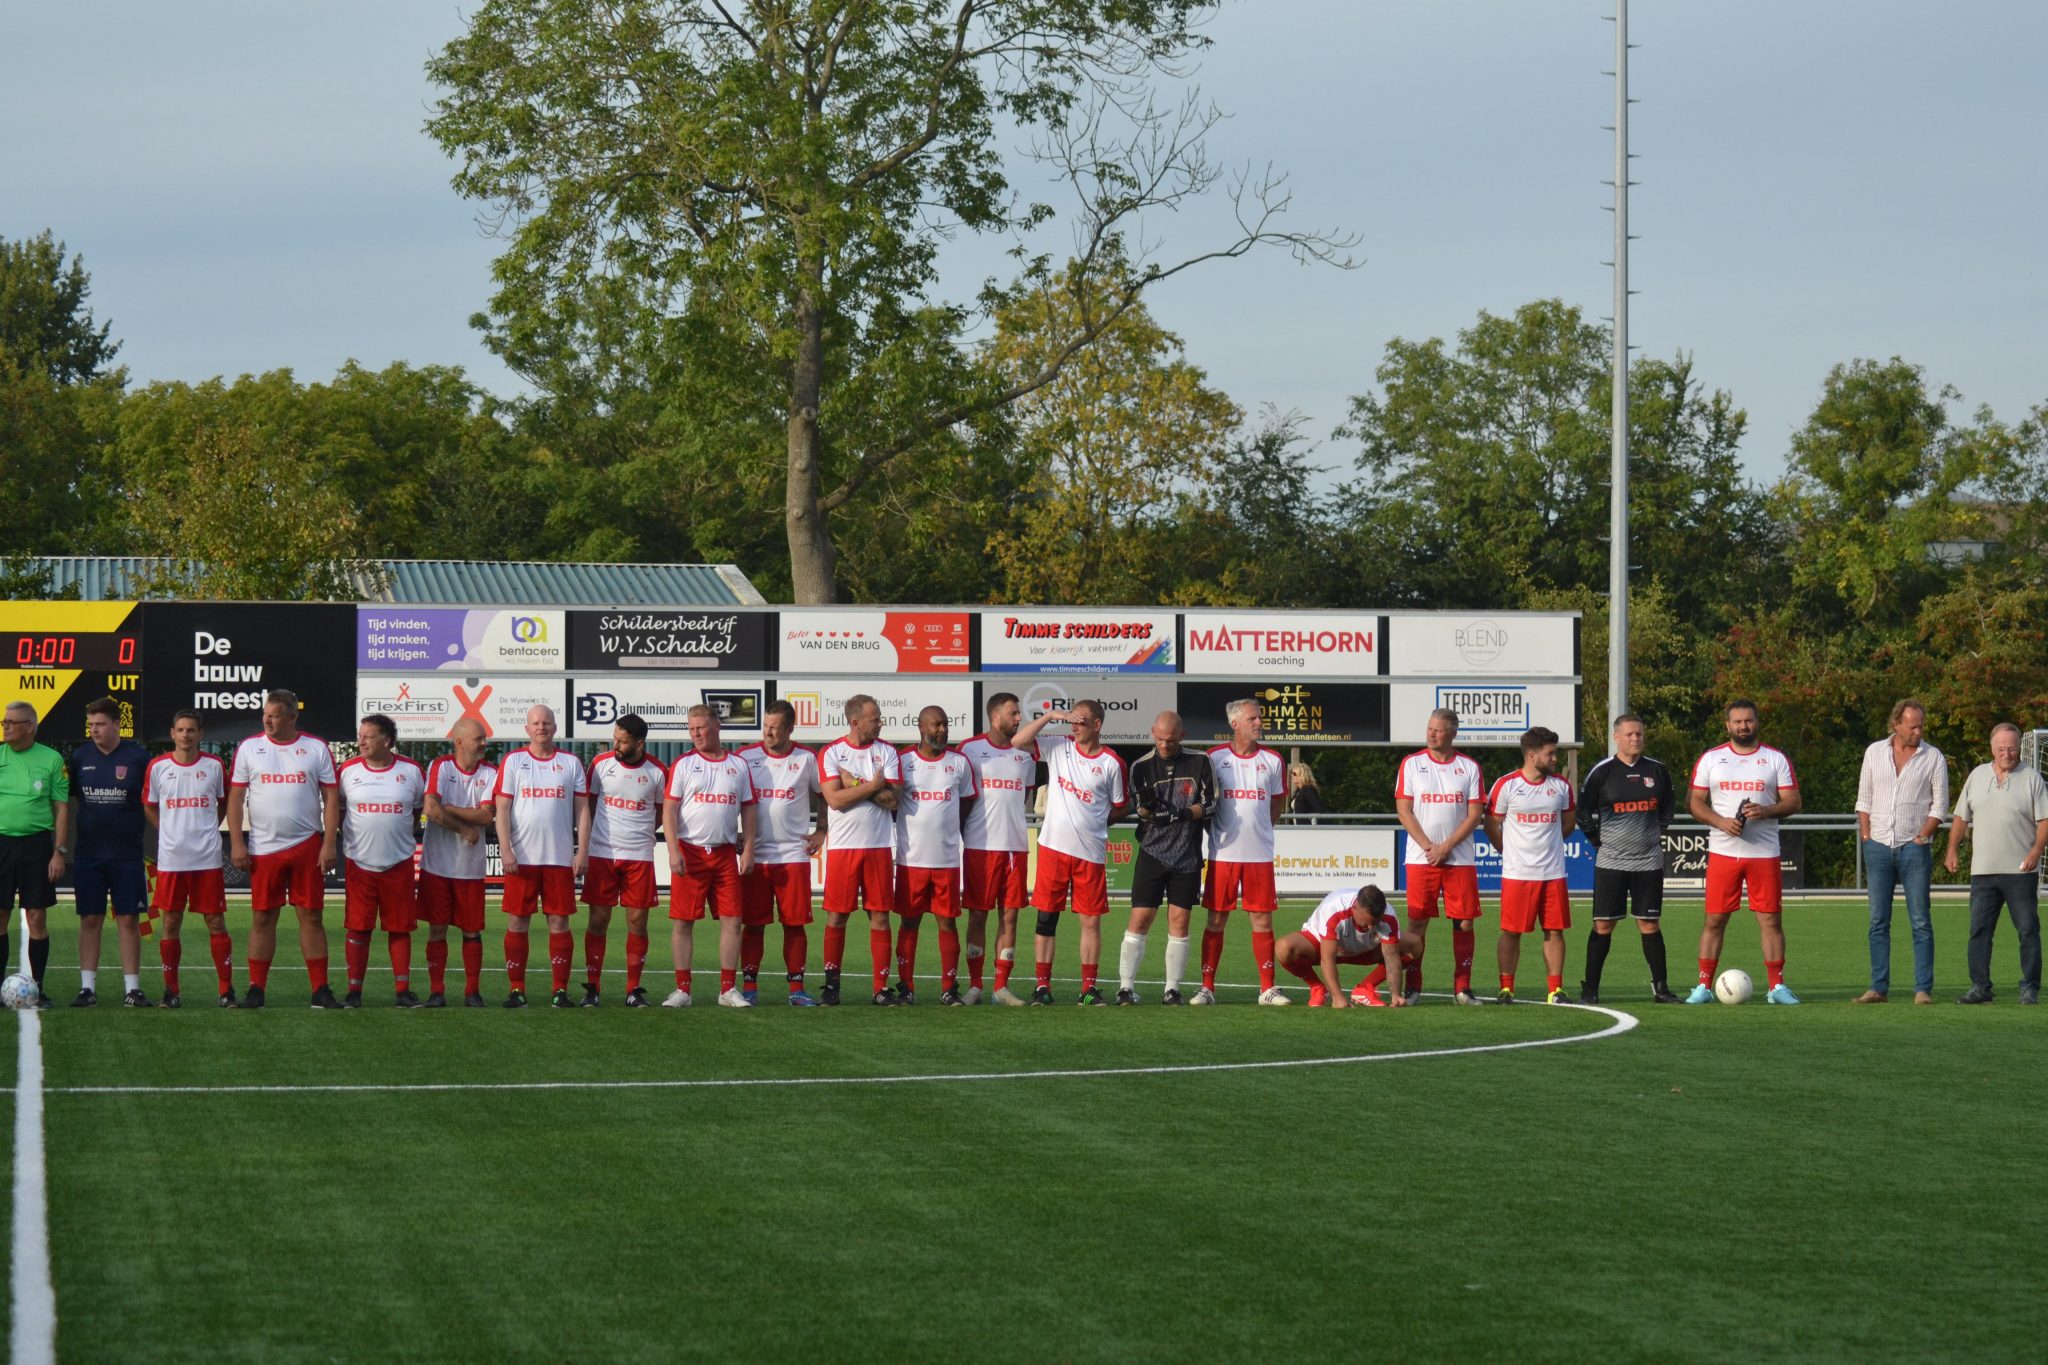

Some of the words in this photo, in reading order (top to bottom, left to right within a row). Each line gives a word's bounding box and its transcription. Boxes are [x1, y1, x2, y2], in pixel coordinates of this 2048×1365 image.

[368, 619, 386, 631] Tijd
[389, 619, 431, 631] vinden,
[600, 615, 737, 634] Schildersbedrijf
[1004, 617, 1061, 639] TIMME
[1063, 623, 1153, 639] SCHILDERS
[368, 634, 386, 645] tijd
[388, 634, 430, 645] maken,
[787, 630, 810, 640] Beter
[1190, 623, 1373, 653] MATTERHORN
[1455, 629, 1508, 647] BLEND
[195, 632, 231, 655] De
[800, 641, 822, 649] VAN
[825, 641, 848, 650] DEN
[851, 641, 880, 650] BRUG
[119, 638, 135, 664] 0
[368, 649, 386, 660] tijd
[388, 649, 430, 660] krijgen.
[500, 646, 559, 656] bentacera
[1030, 646, 1046, 654] Voor
[1050, 645, 1083, 656] kleurrijk
[1258, 656, 1305, 667] coaching
[195, 659, 262, 682] bouw
[1040, 665, 1119, 673] www.timmeschilders.nl
[20, 675, 55, 689] MIN
[108, 675, 139, 690] UIT
[366, 701, 445, 712] FlexFirst
[1443, 693, 1522, 715] TERPSTRA
[1262, 719, 1323, 730] ETSEN
[1264, 733, 1352, 741] www.lohmanfietsen.nl
[90, 786, 128, 796] Lasaulec
[1113, 852, 1132, 864] BV
[1273, 855, 1339, 869] derwurk
[1344, 855, 1390, 869] Rinse
[1672, 853, 1709, 873] Fash
